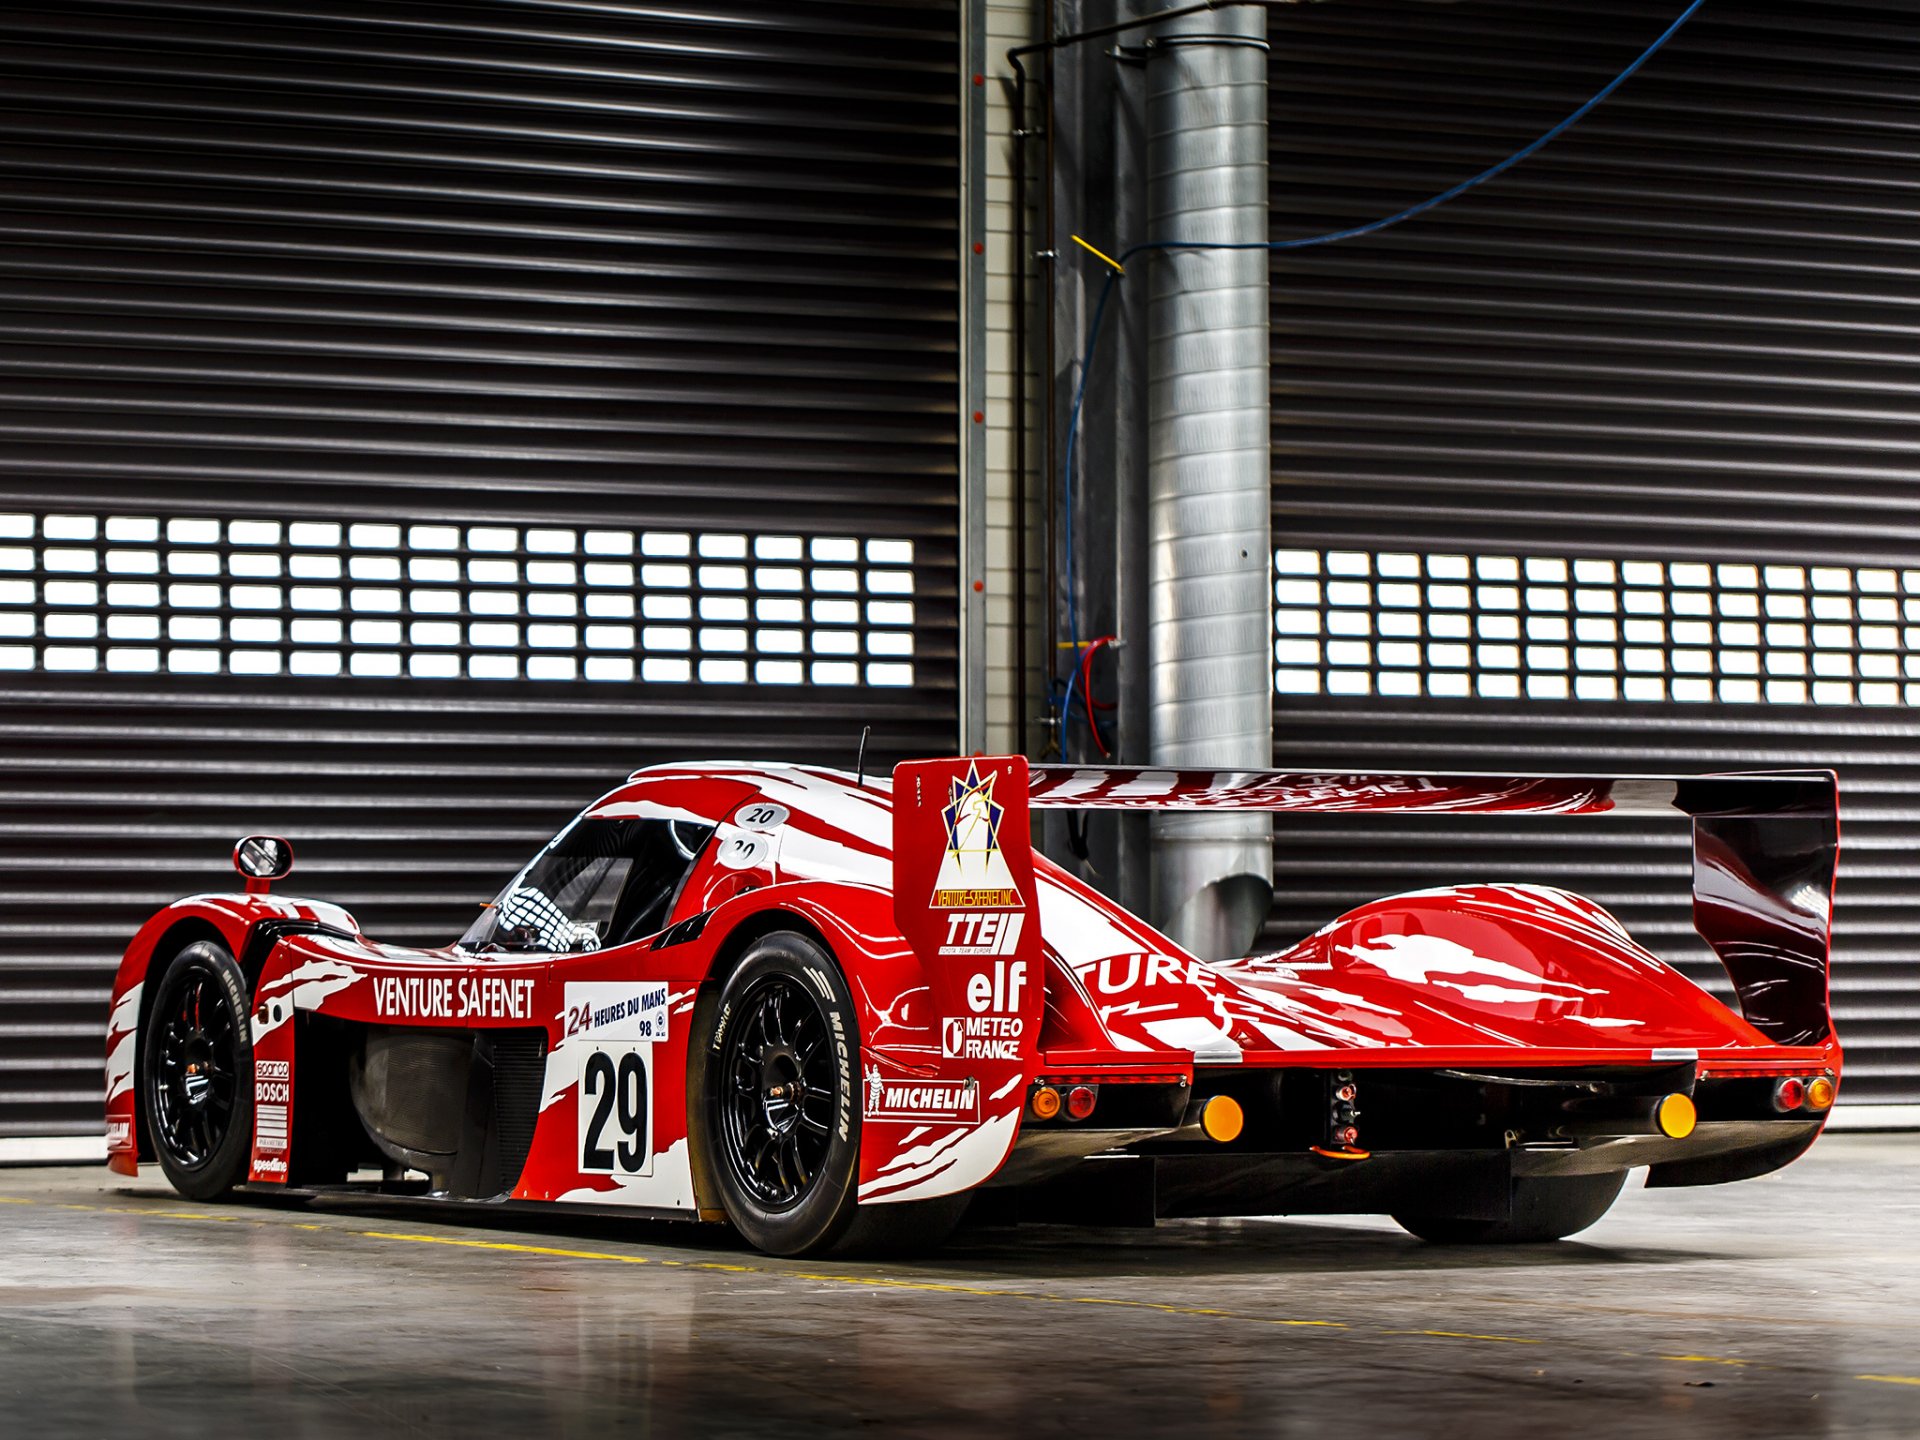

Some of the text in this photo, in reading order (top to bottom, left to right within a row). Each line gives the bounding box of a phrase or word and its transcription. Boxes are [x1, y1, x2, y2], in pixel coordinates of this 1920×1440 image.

[745, 807, 775, 824] 20
[946, 913, 1000, 945] TTE
[373, 977, 535, 1019] VENTURE SAFENET
[967, 961, 1027, 1013] elf
[222, 969, 247, 1043] MICHELIN
[567, 988, 666, 1037] 24 HEURES DU MANS
[639, 1020, 651, 1037] 98
[966, 1017, 1024, 1037] METEO
[966, 1039, 1021, 1059] FRANCE
[256, 1062, 289, 1076] sparco
[829, 1012, 851, 1142] MICHELIN
[256, 1082, 290, 1102] BOSCH
[885, 1088, 975, 1110] MICHELIN
[583, 1050, 647, 1173] 29
[253, 1157, 287, 1173] speedline
